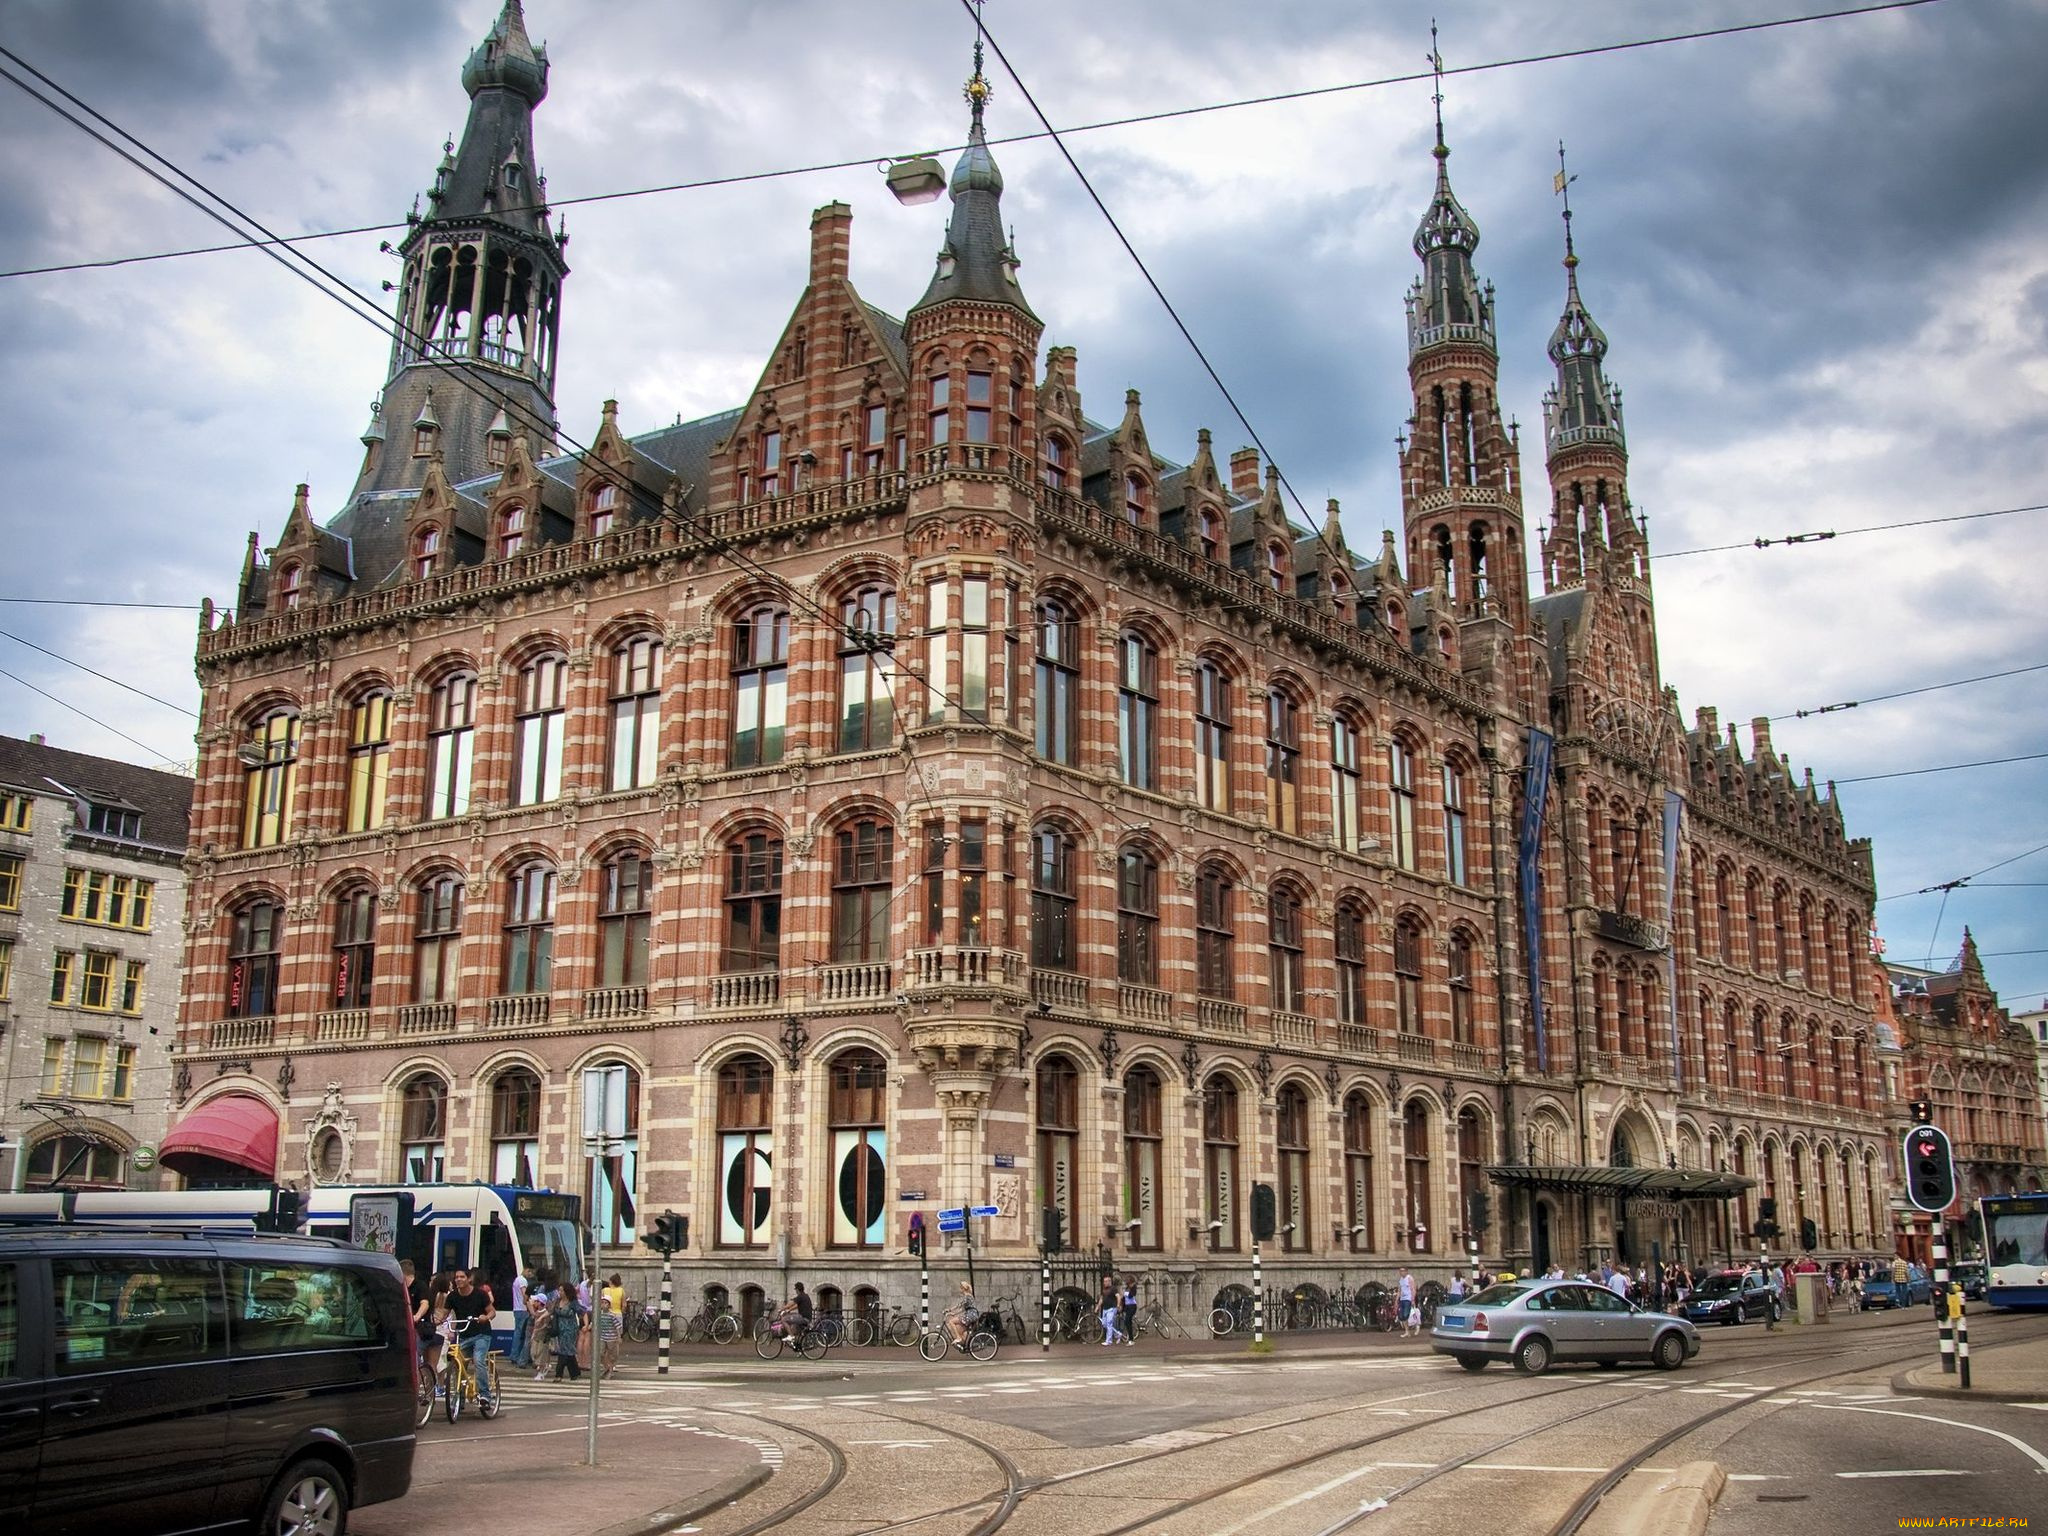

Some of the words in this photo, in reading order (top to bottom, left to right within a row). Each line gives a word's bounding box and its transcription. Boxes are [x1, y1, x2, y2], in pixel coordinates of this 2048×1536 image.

[231, 965, 242, 1007] REPLAY
[338, 954, 349, 997] REPLAY
[1141, 1176, 1150, 1211] MNG
[1220, 1171, 1228, 1224] MANGO
